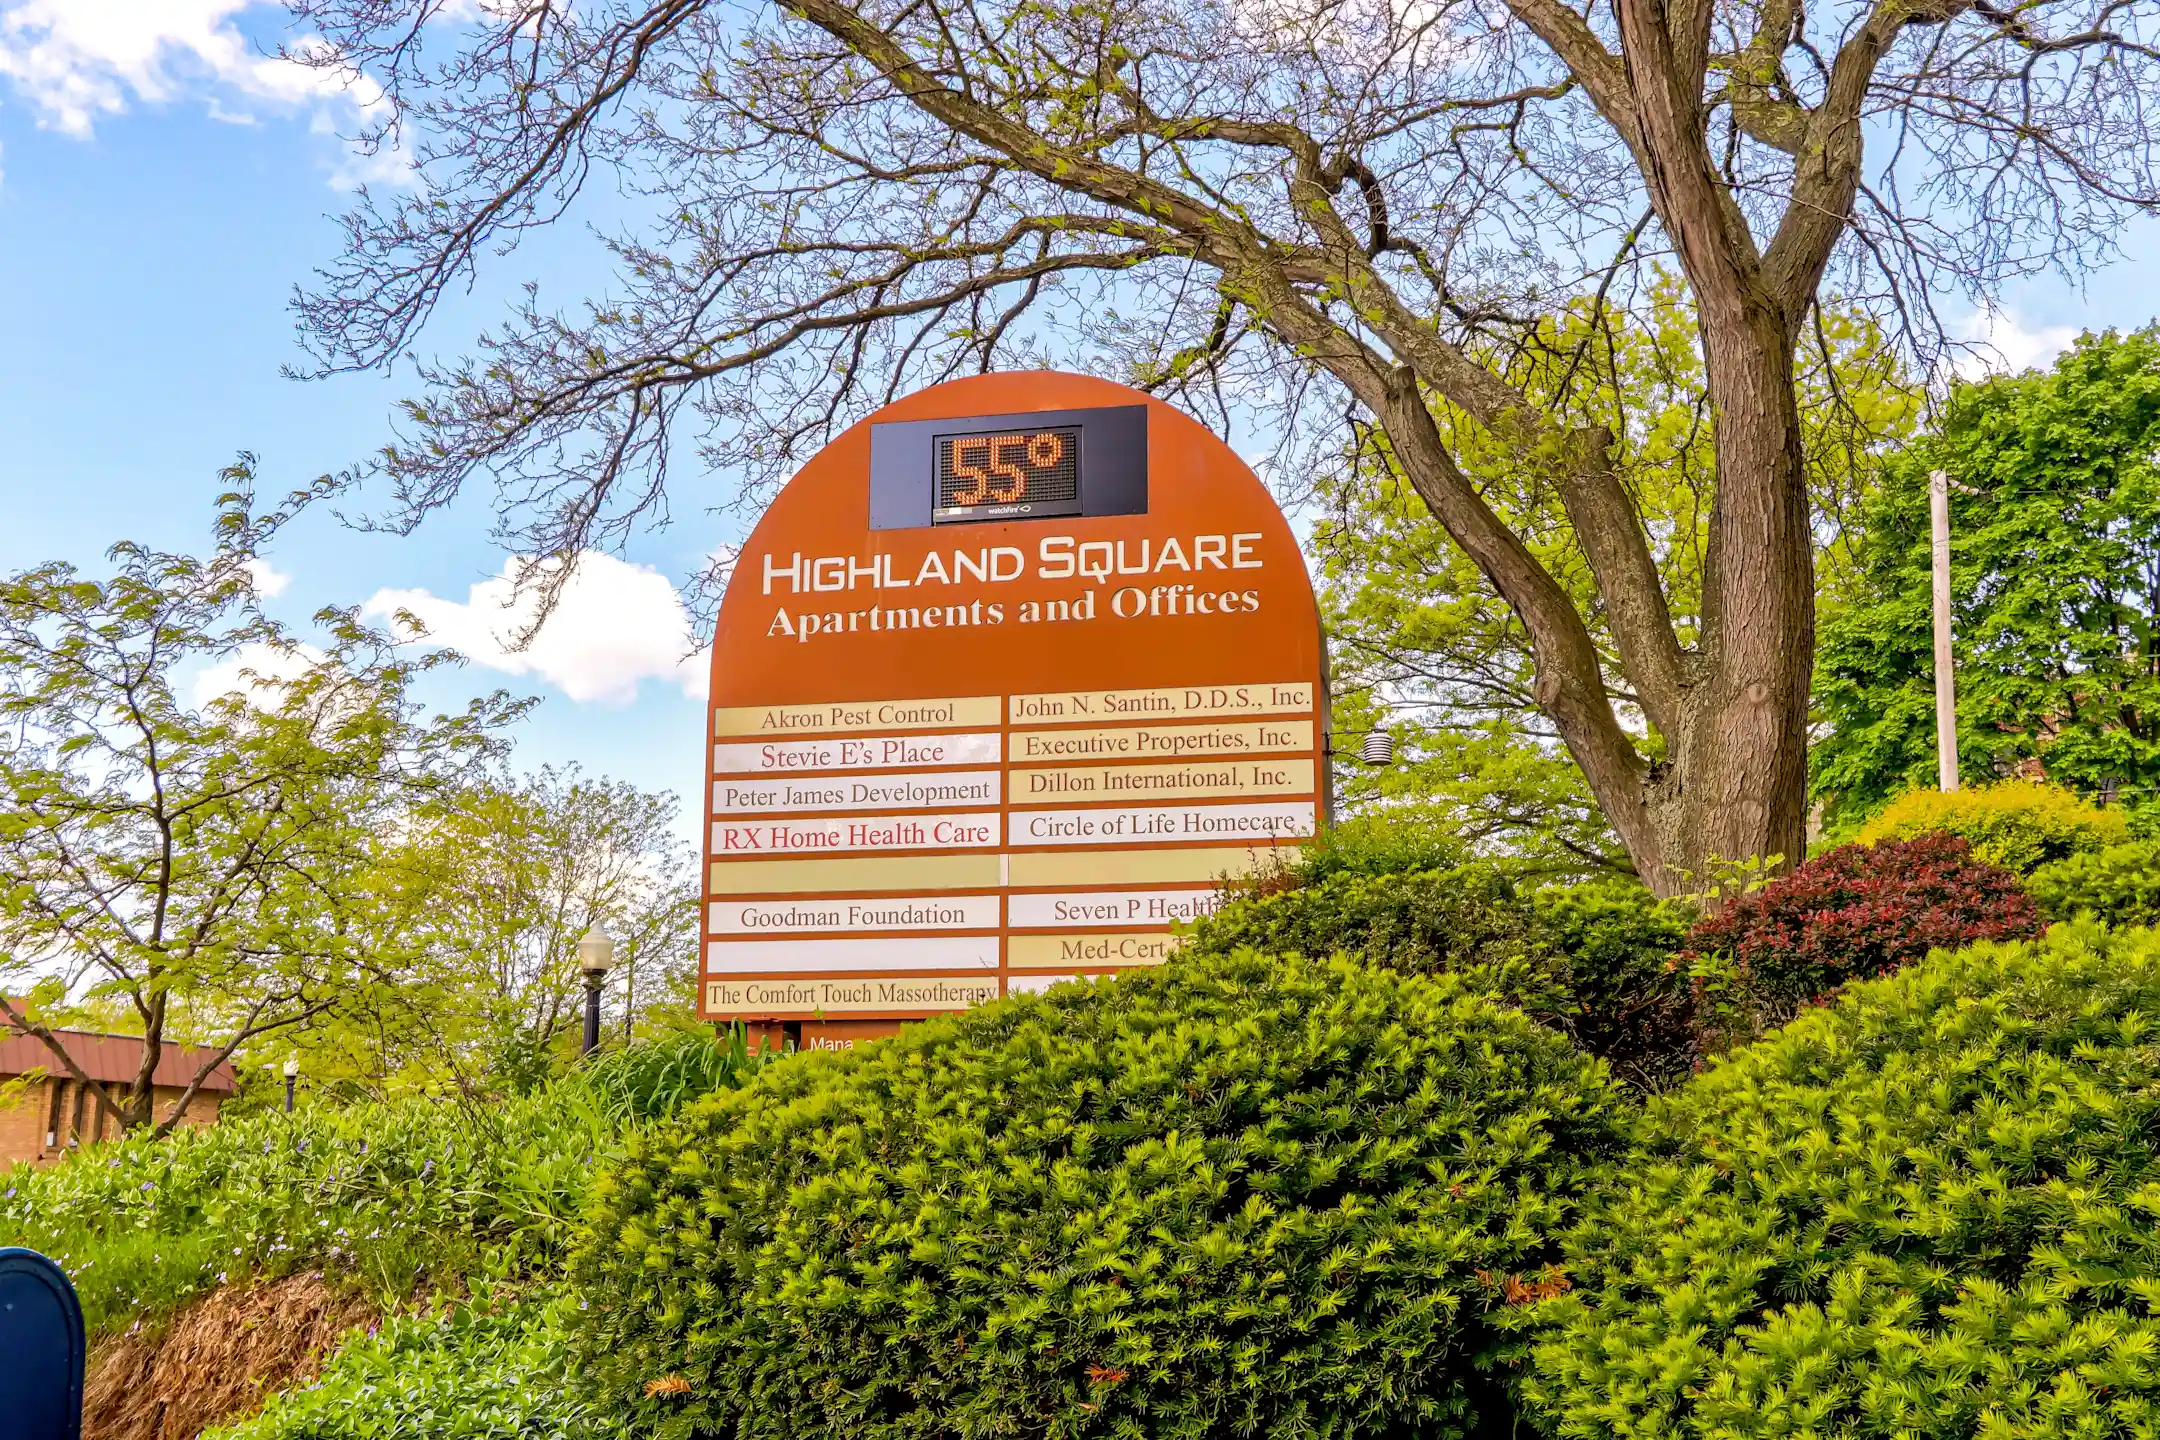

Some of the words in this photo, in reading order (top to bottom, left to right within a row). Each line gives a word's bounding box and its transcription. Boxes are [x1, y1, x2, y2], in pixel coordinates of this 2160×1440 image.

[987, 505, 1019, 515] watchfire
[762, 545, 1025, 595] HIGHLAND
[1038, 532, 1263, 584] SQUARE
[766, 598, 1004, 644] Apartments
[1018, 589, 1096, 623] and
[1111, 583, 1260, 619] Offices
[1016, 698, 1064, 717] John
[1071, 695, 1095, 714] N.
[1104, 691, 1176, 714] Santin,
[1184, 688, 1263, 710] D.D.S.,
[1271, 686, 1310, 706] Inc.
[761, 710, 823, 729] Akron
[831, 707, 871, 726] Pest
[878, 703, 954, 724] Control
[761, 745, 831, 768] Stevie
[840, 741, 873, 765] E's
[881, 740, 944, 763] Place
[1025, 733, 1129, 756] Executive
[1136, 728, 1250, 755] Properties,
[1258, 727, 1298, 746] Inc.
[1030, 771, 1095, 793] Dillon
[1103, 766, 1244, 790] International,
[1252, 766, 1292, 786] Inc.
[725, 788, 777, 807] Peter
[783, 786, 844, 805] James
[851, 781, 990, 805] Development
[723, 827, 762, 850] RX
[771, 826, 840, 848] Home
[848, 822, 926, 846] Health
[933, 821, 990, 844] Care
[1030, 816, 1095, 837] Circle
[1102, 814, 1126, 835] of
[1131, 813, 1176, 834] Life
[1182, 812, 1295, 833] Homecare
[741, 907, 840, 927] Goodman
[848, 903, 965, 926] Foundation
[1054, 900, 1119, 921] Seven
[1126, 899, 1141, 919] P
[1147, 896, 1220, 919] Health
[1060, 938, 1165, 961] Med-Cert
[709, 985, 740, 1004] The
[746, 984, 816, 1003] Comfort
[821, 983, 871, 1003] Touch
[878, 981, 996, 1003] Massotherapy
